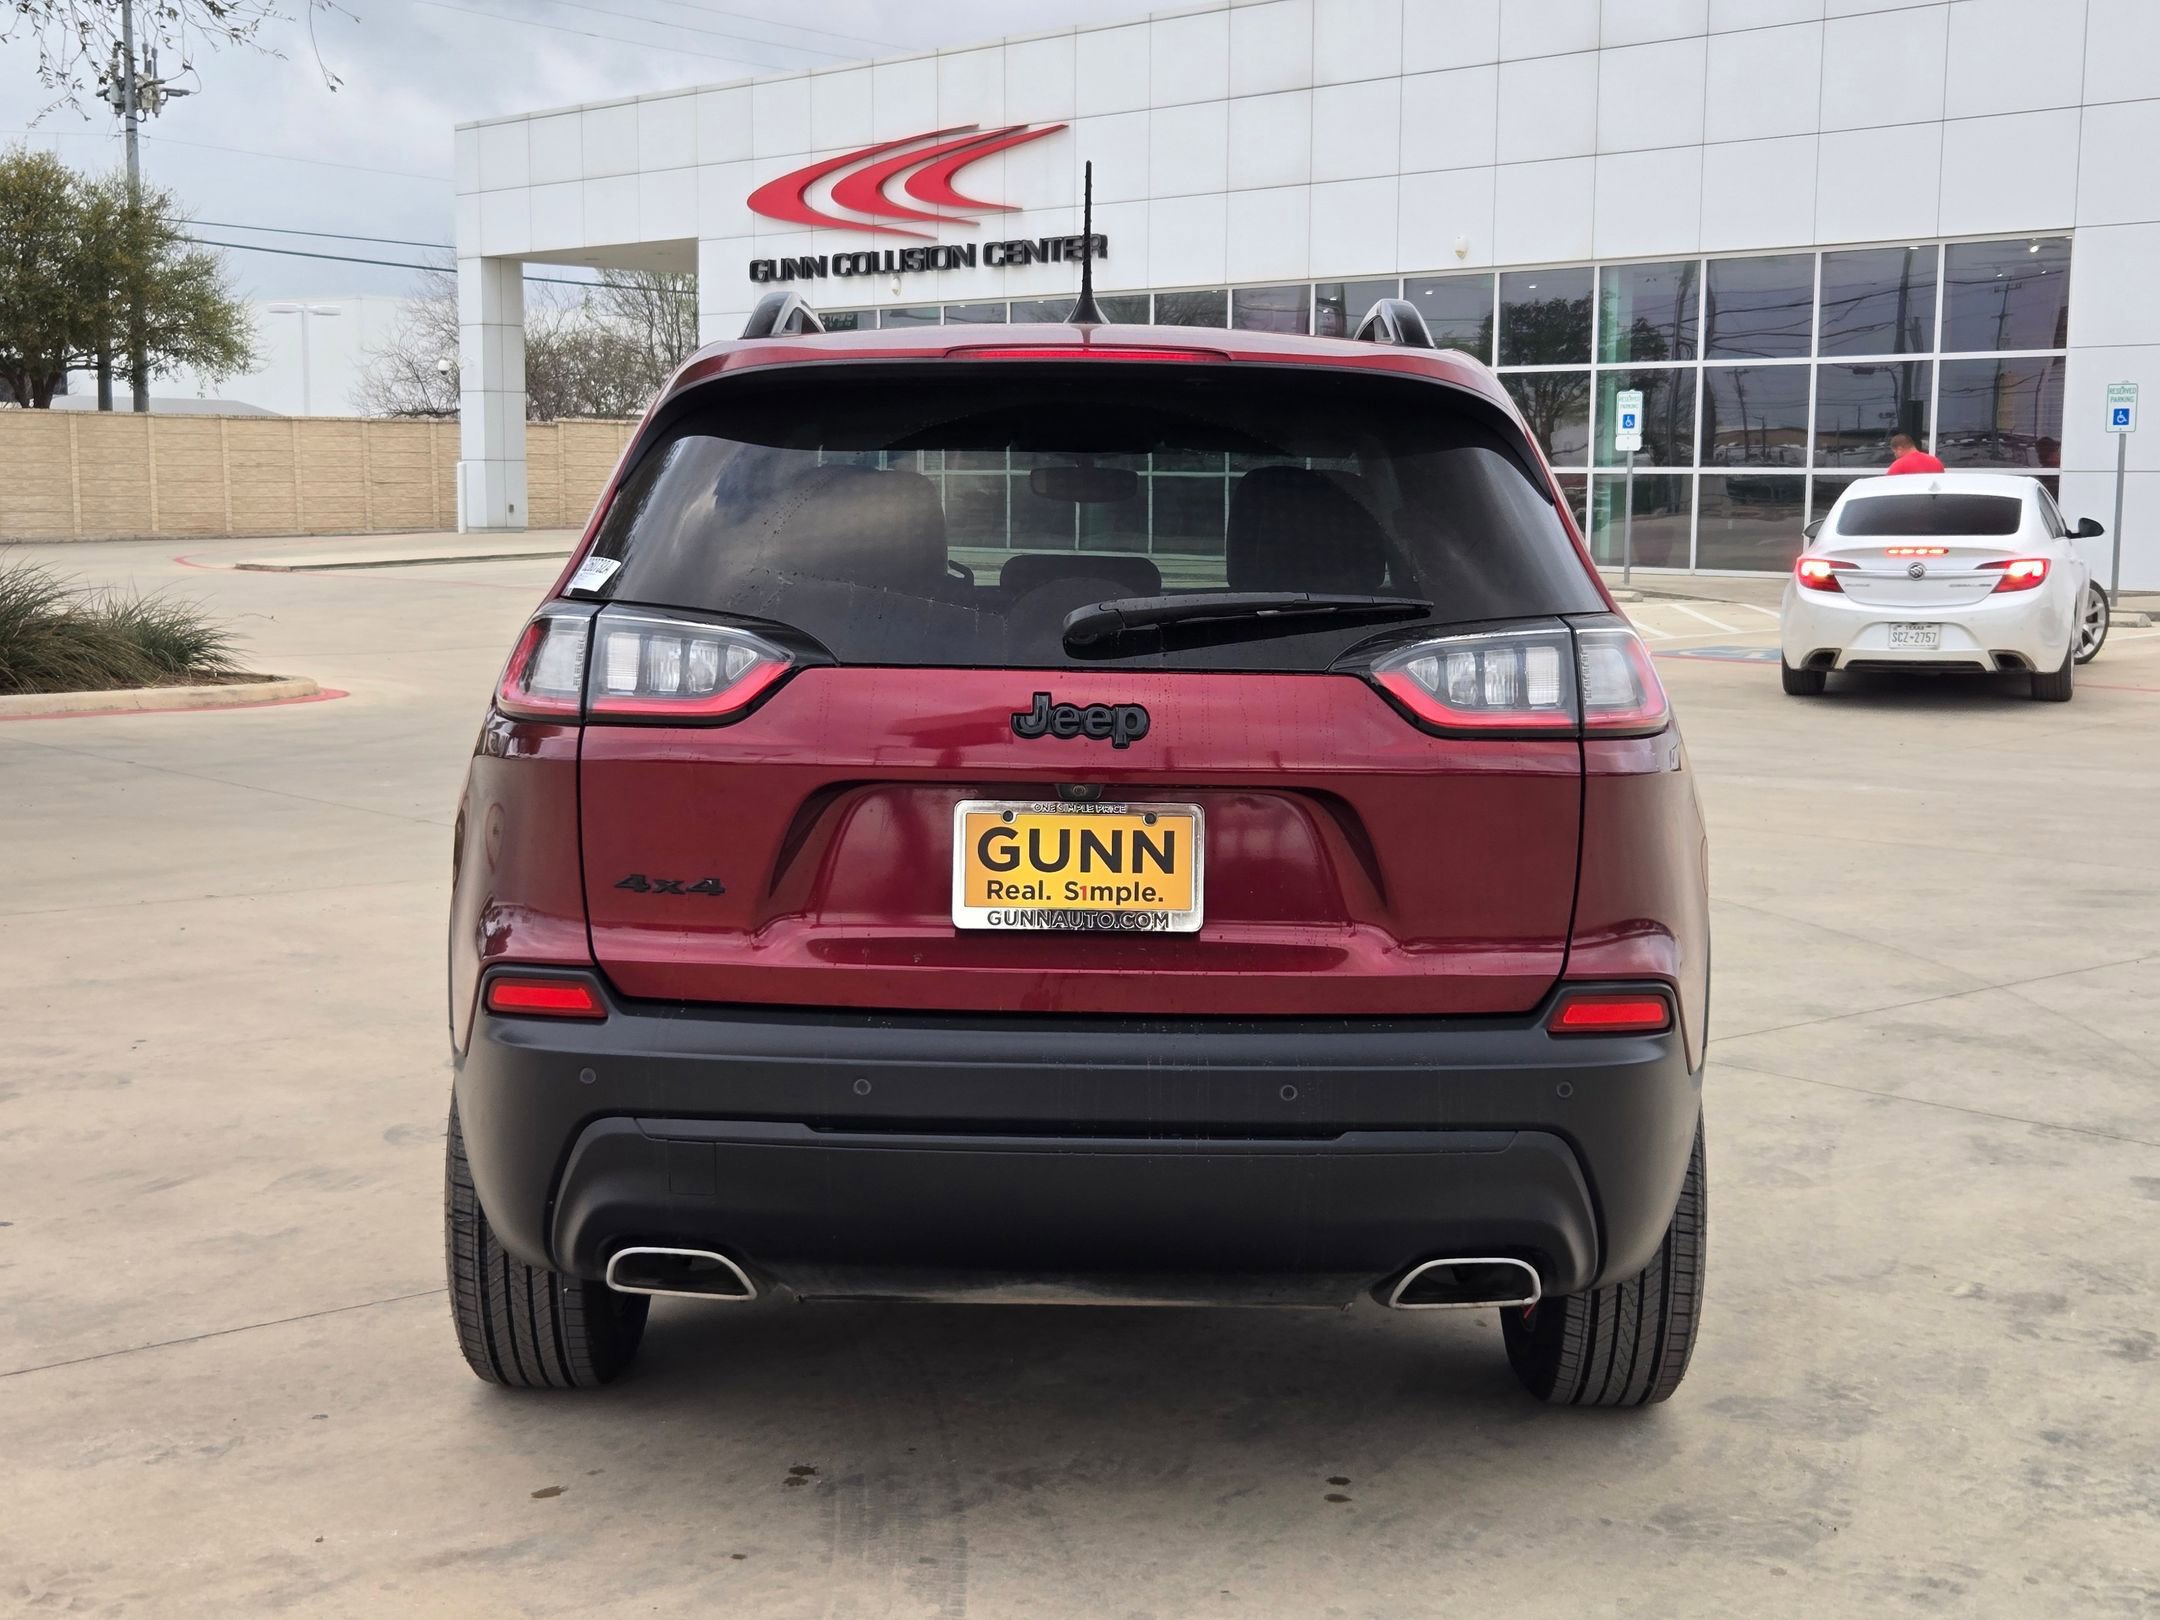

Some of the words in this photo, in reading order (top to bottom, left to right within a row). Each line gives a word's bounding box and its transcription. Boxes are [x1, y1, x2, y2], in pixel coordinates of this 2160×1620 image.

[749, 255, 828, 283] GUNN
[831, 243, 977, 277] COLLISION
[983, 233, 1109, 268] CENTER
[1010, 691, 1150, 749] Jeep
[1033, 802, 1056, 813] ONE
[1056, 803, 1095, 814] SIMPLE
[1095, 804, 1128, 815] PRICE
[977, 826, 1176, 875] GUNN
[986, 879, 1052, 901] Real.
[986, 909, 1170, 930] GUNNAUTO.COM
